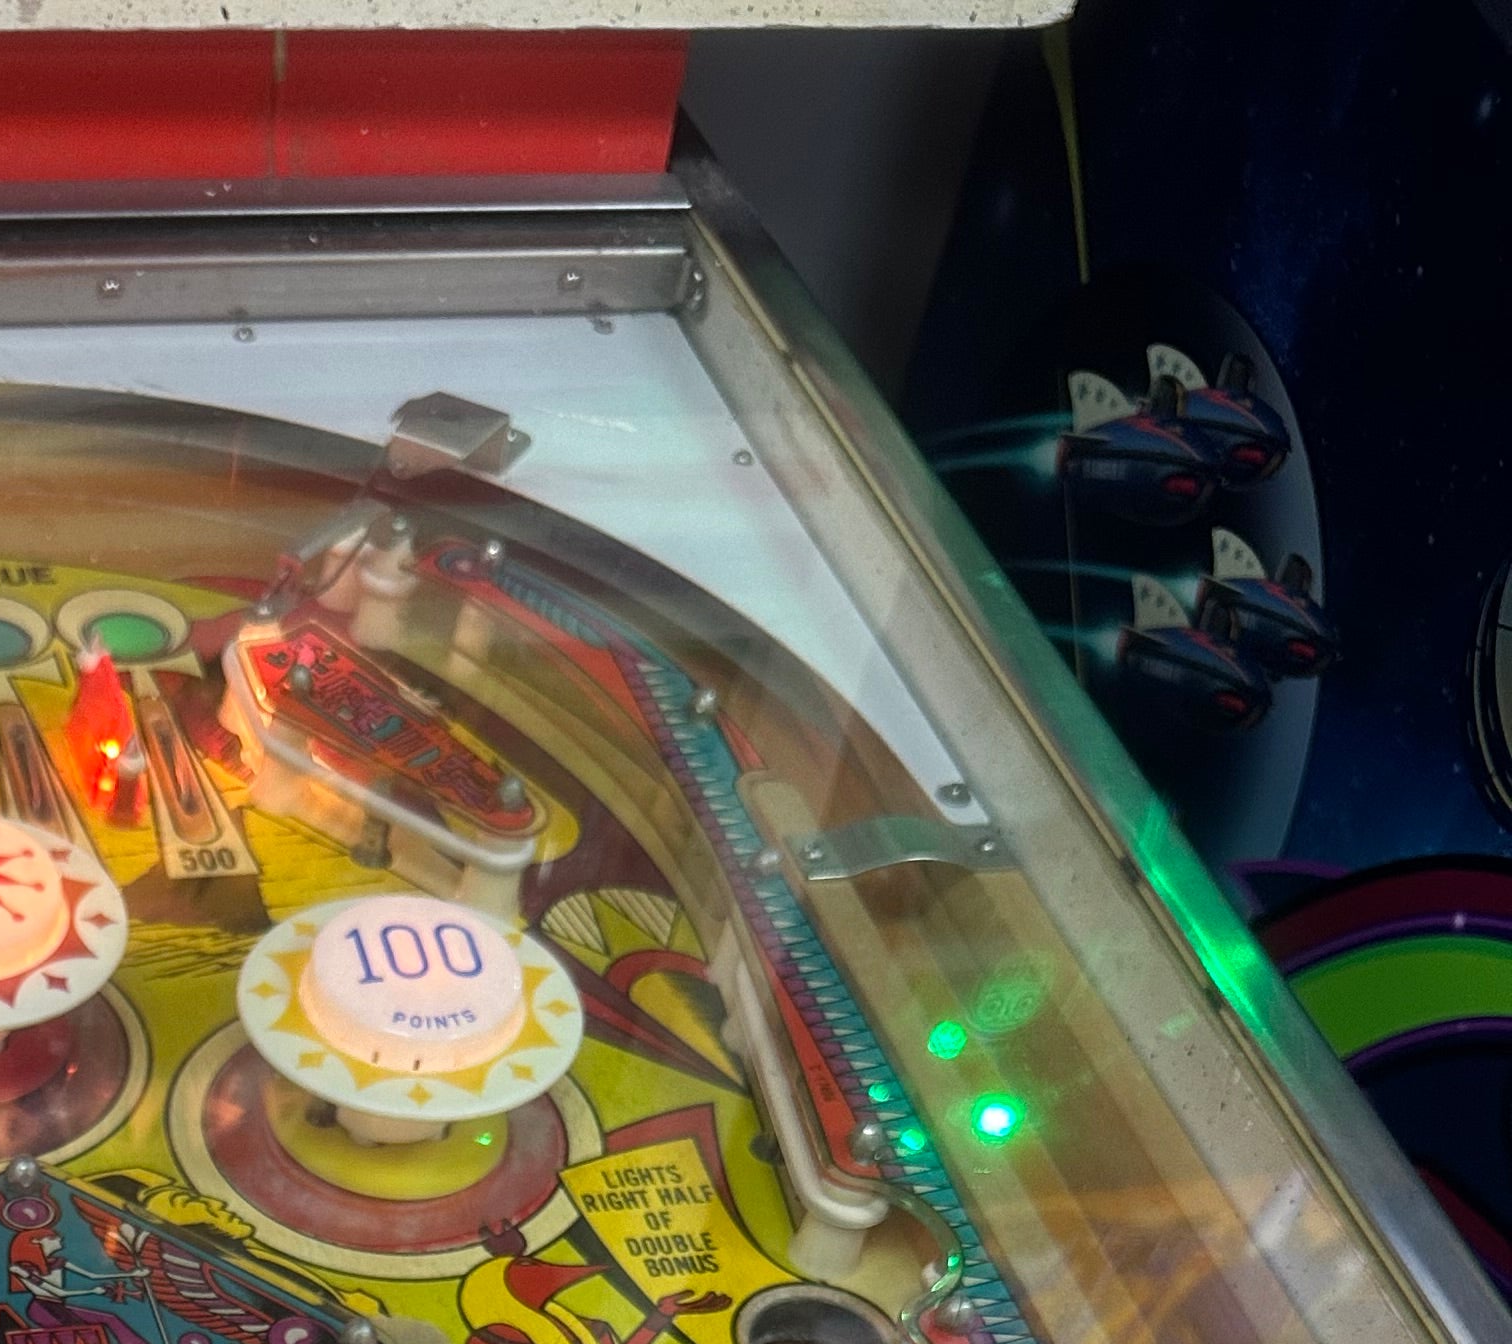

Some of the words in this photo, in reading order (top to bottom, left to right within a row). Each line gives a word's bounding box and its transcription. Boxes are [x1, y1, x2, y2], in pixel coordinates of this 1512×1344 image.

[178, 847, 236, 872] 500
[345, 923, 483, 985] 100
[392, 1010, 477, 1030] POINTS
[601, 1164, 683, 1190] LIGHTS
[581, 1189, 651, 1213] RIGHT
[656, 1183, 715, 1207] HALF
[644, 1210, 673, 1231] OF
[626, 1232, 718, 1257] DOUBLE
[643, 1254, 720, 1278] BONUS
